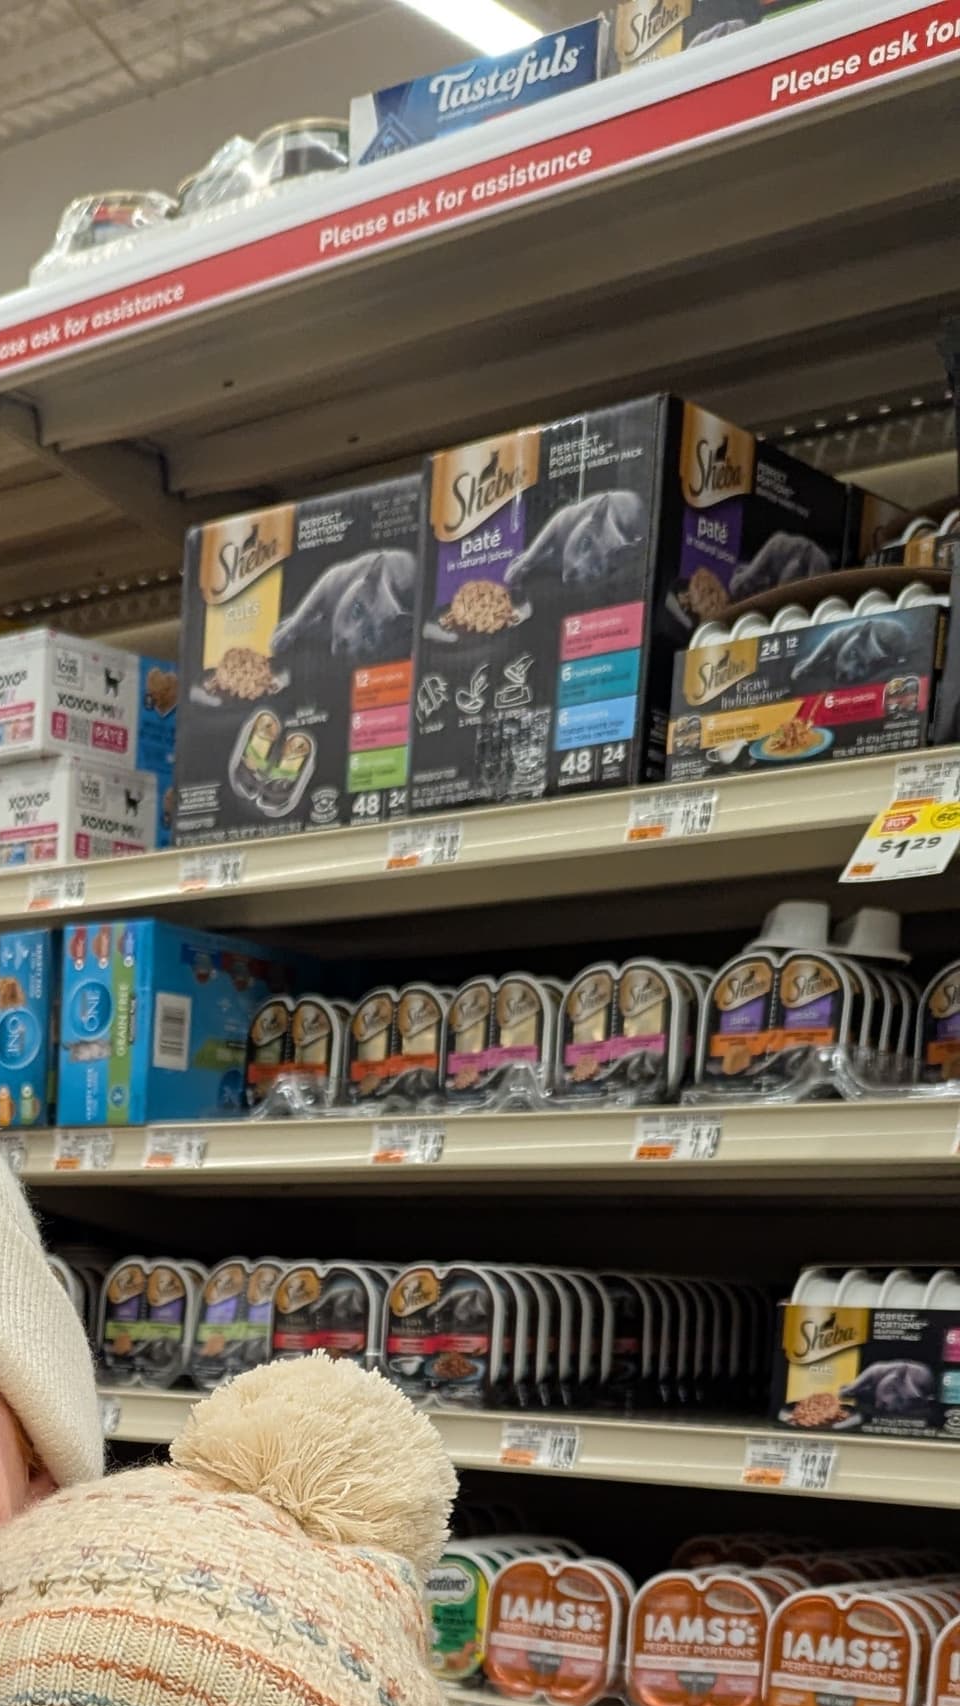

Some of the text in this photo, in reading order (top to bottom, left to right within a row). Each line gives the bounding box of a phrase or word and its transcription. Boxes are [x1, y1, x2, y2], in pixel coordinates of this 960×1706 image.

[429, 35, 579, 112] Tastefuls
[770, 53, 861, 101] Please
[868, 29, 918, 67] ask
[319, 147, 592, 252] Please ask for assistance
[31, 323, 60, 348] ask
[64, 315, 88, 338] for
[92, 283, 186, 330] assistance
[549, 433, 600, 457] PERFECT
[688, 439, 742, 497] Sheba
[443, 466, 526, 533] Sheba
[461, 528, 502, 559] paté
[761, 636, 800, 657] 24 12
[561, 664, 572, 681] 6
[824, 694, 836, 709] 6
[560, 743, 626, 776] 48 24
[352, 792, 381, 817] 48
[84, 990, 101, 1032] ONE
[116, 982, 129, 1057] GRAIN FREE
[873, 1311, 917, 1322] PERFECT
[793, 1318, 856, 1358] Sheba
[500, 1593, 575, 1630] IAMS
[543, 1628, 600, 1645] PORTIONS
[644, 1613, 727, 1647] IAMS
[643, 1642, 754, 1658] PERFECT PORTIONS
[782, 1630, 868, 1668] IAMS
[780, 1660, 896, 1684] PERFECT PORTIONS
